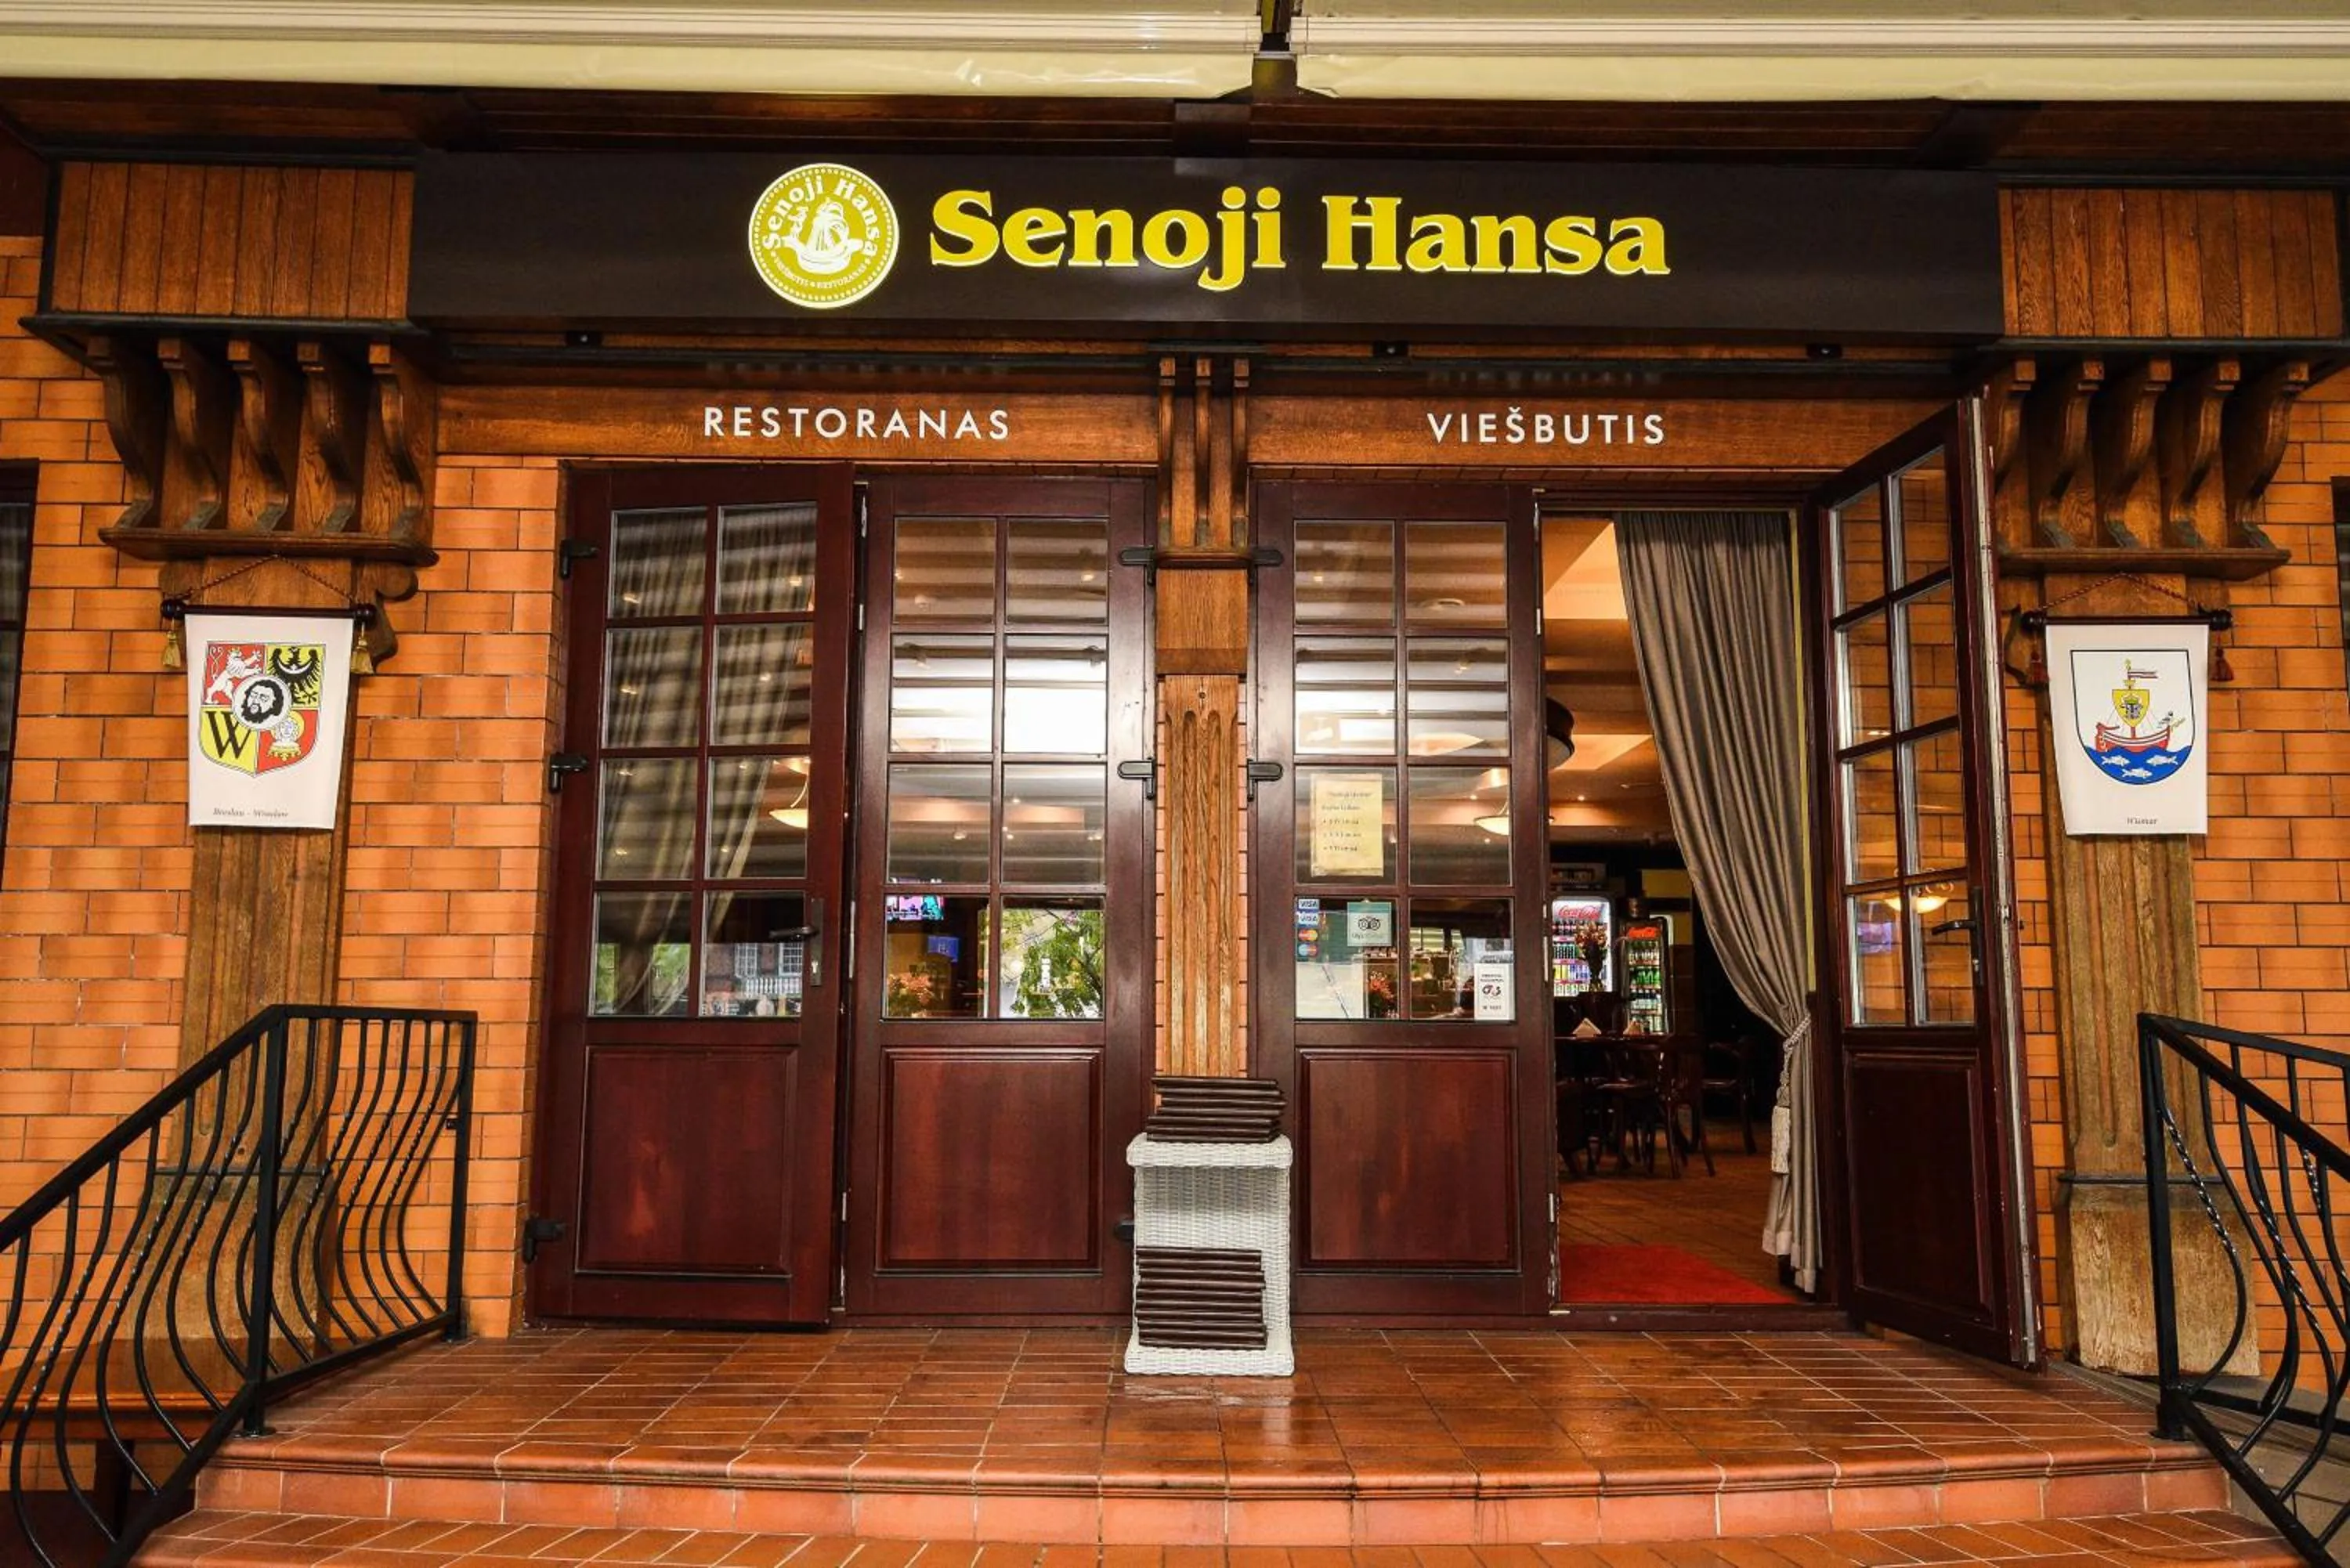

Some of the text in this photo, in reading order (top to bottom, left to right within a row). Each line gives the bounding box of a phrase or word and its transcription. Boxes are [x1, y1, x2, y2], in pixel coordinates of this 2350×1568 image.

[762, 175, 880, 256] Senoji Hansa
[930, 186, 1671, 292] Senoji Hansa
[704, 406, 1009, 441] RESTORANAS
[1426, 406, 1664, 444] VIEŠBUTIS
